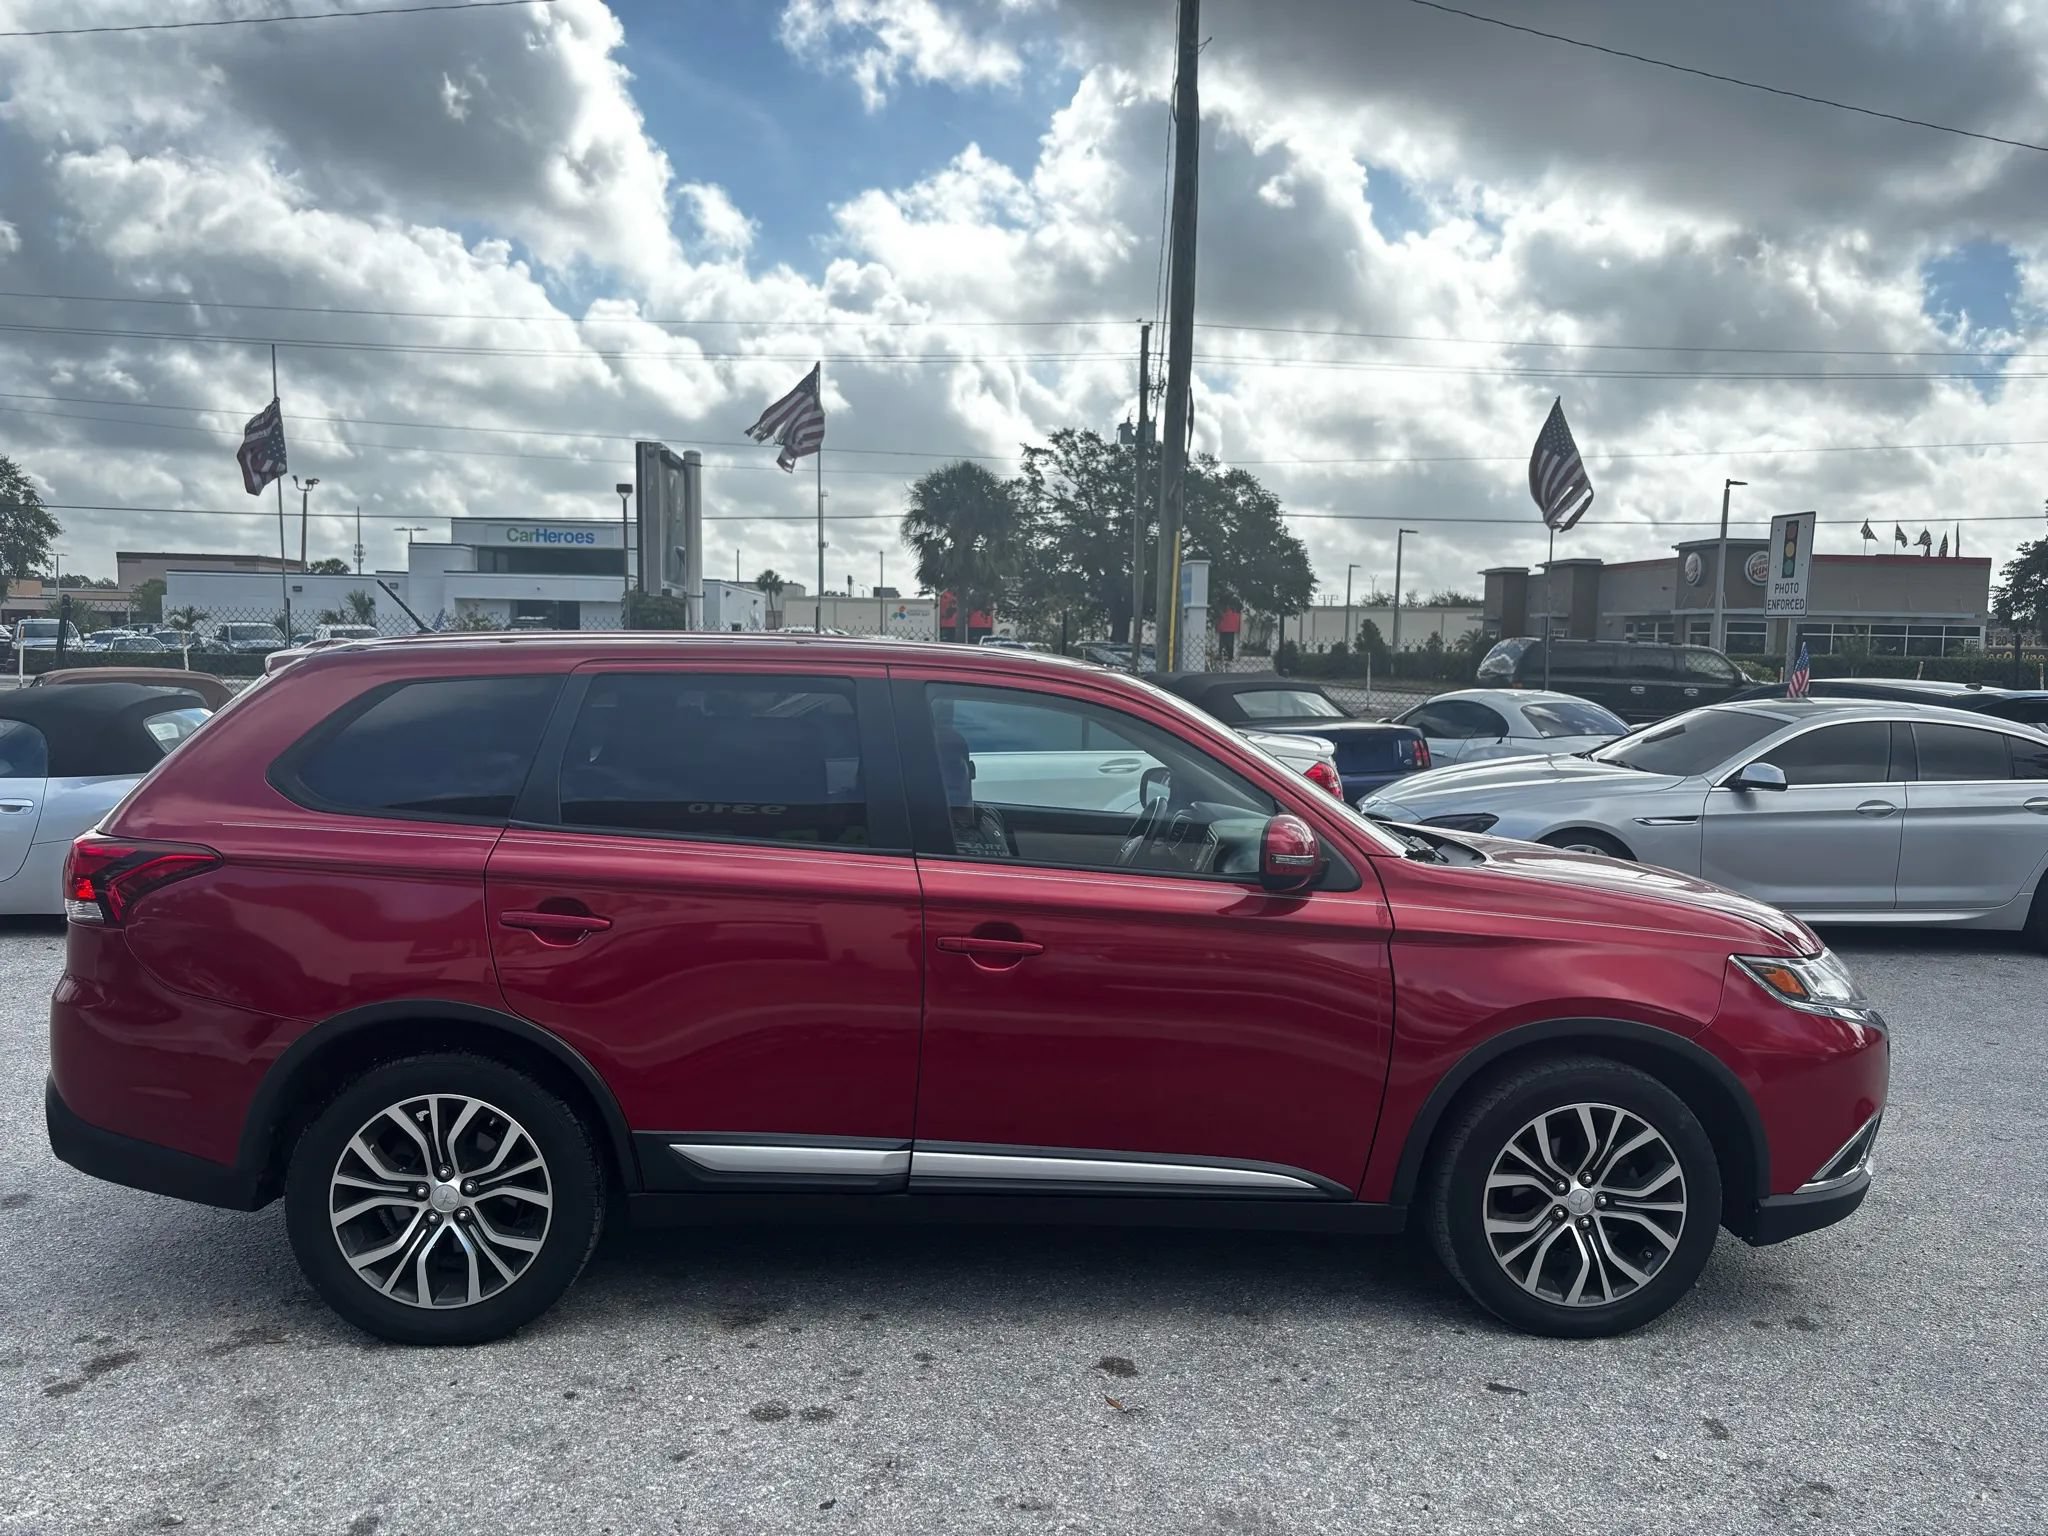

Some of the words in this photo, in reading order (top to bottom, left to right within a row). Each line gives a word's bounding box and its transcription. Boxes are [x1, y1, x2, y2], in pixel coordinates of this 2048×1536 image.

[507, 528, 595, 544] CarHeroes
[1774, 582, 1799, 594] PHOTO
[1768, 598, 1805, 610] ENFORCED
